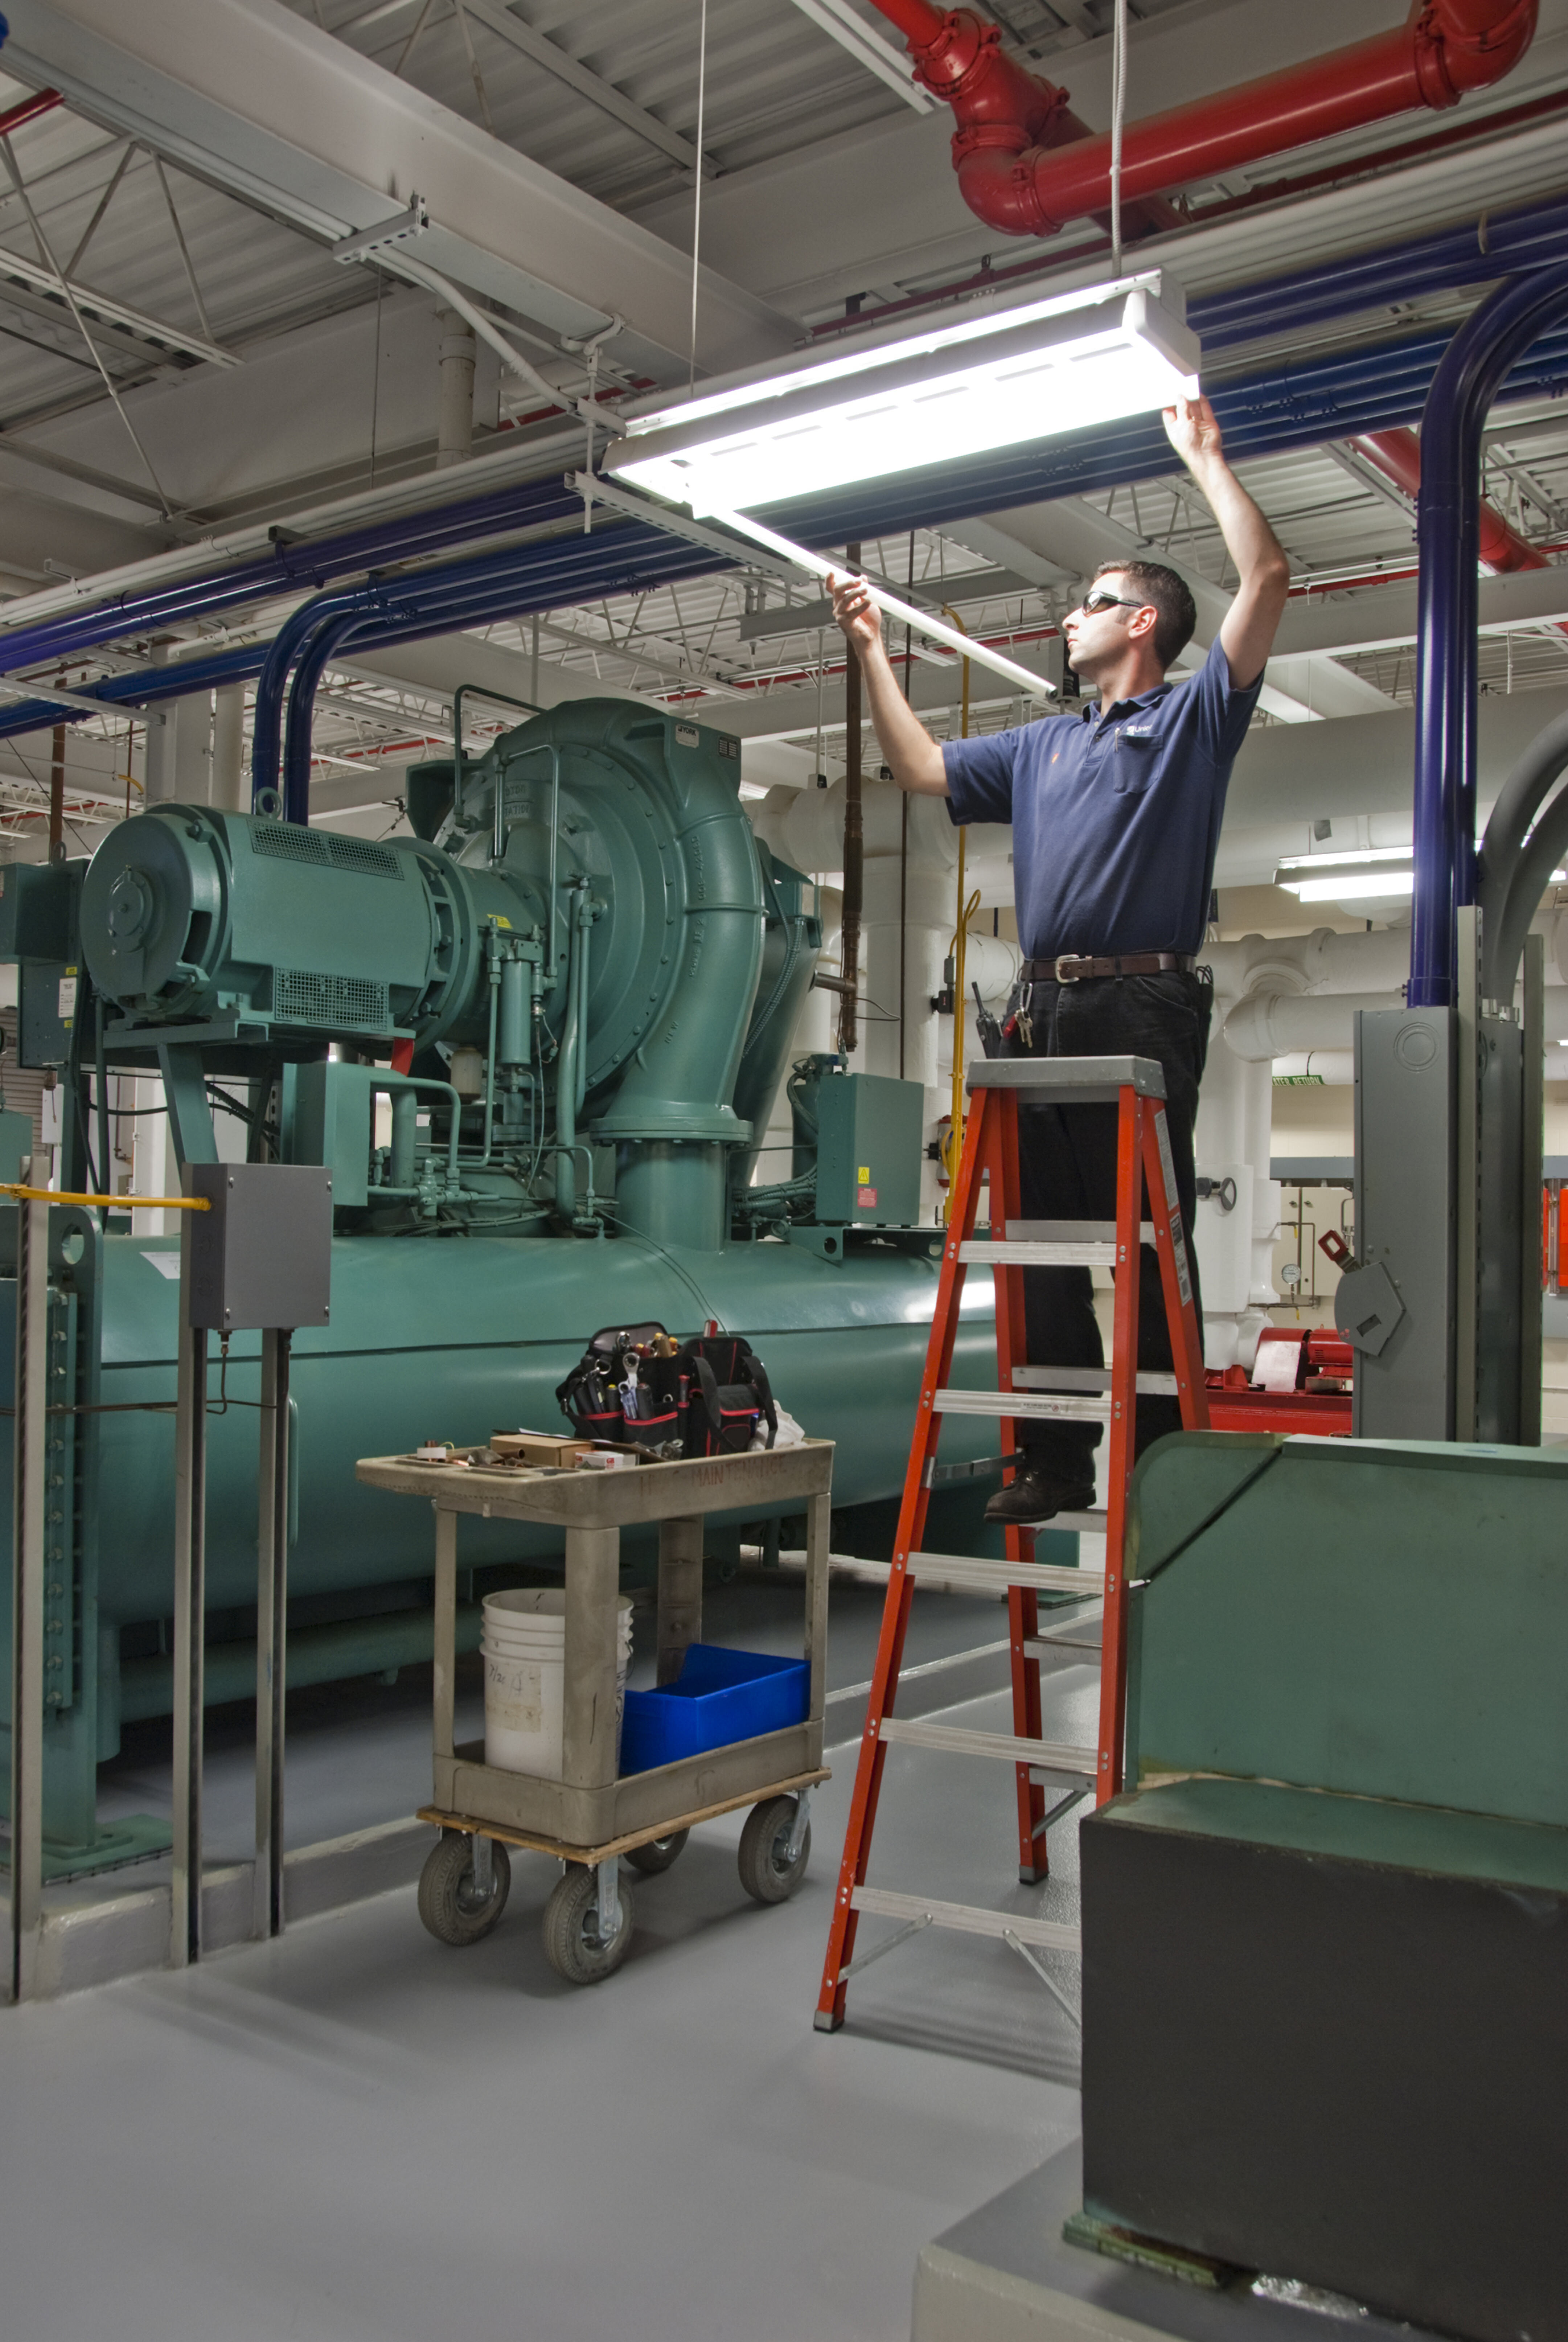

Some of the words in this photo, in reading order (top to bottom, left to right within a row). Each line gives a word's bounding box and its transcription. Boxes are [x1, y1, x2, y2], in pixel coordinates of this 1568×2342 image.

[683, 726, 697, 736] YORK
[1272, 1077, 1292, 1086] ATER
[1292, 1076, 1322, 1086] RETURN
